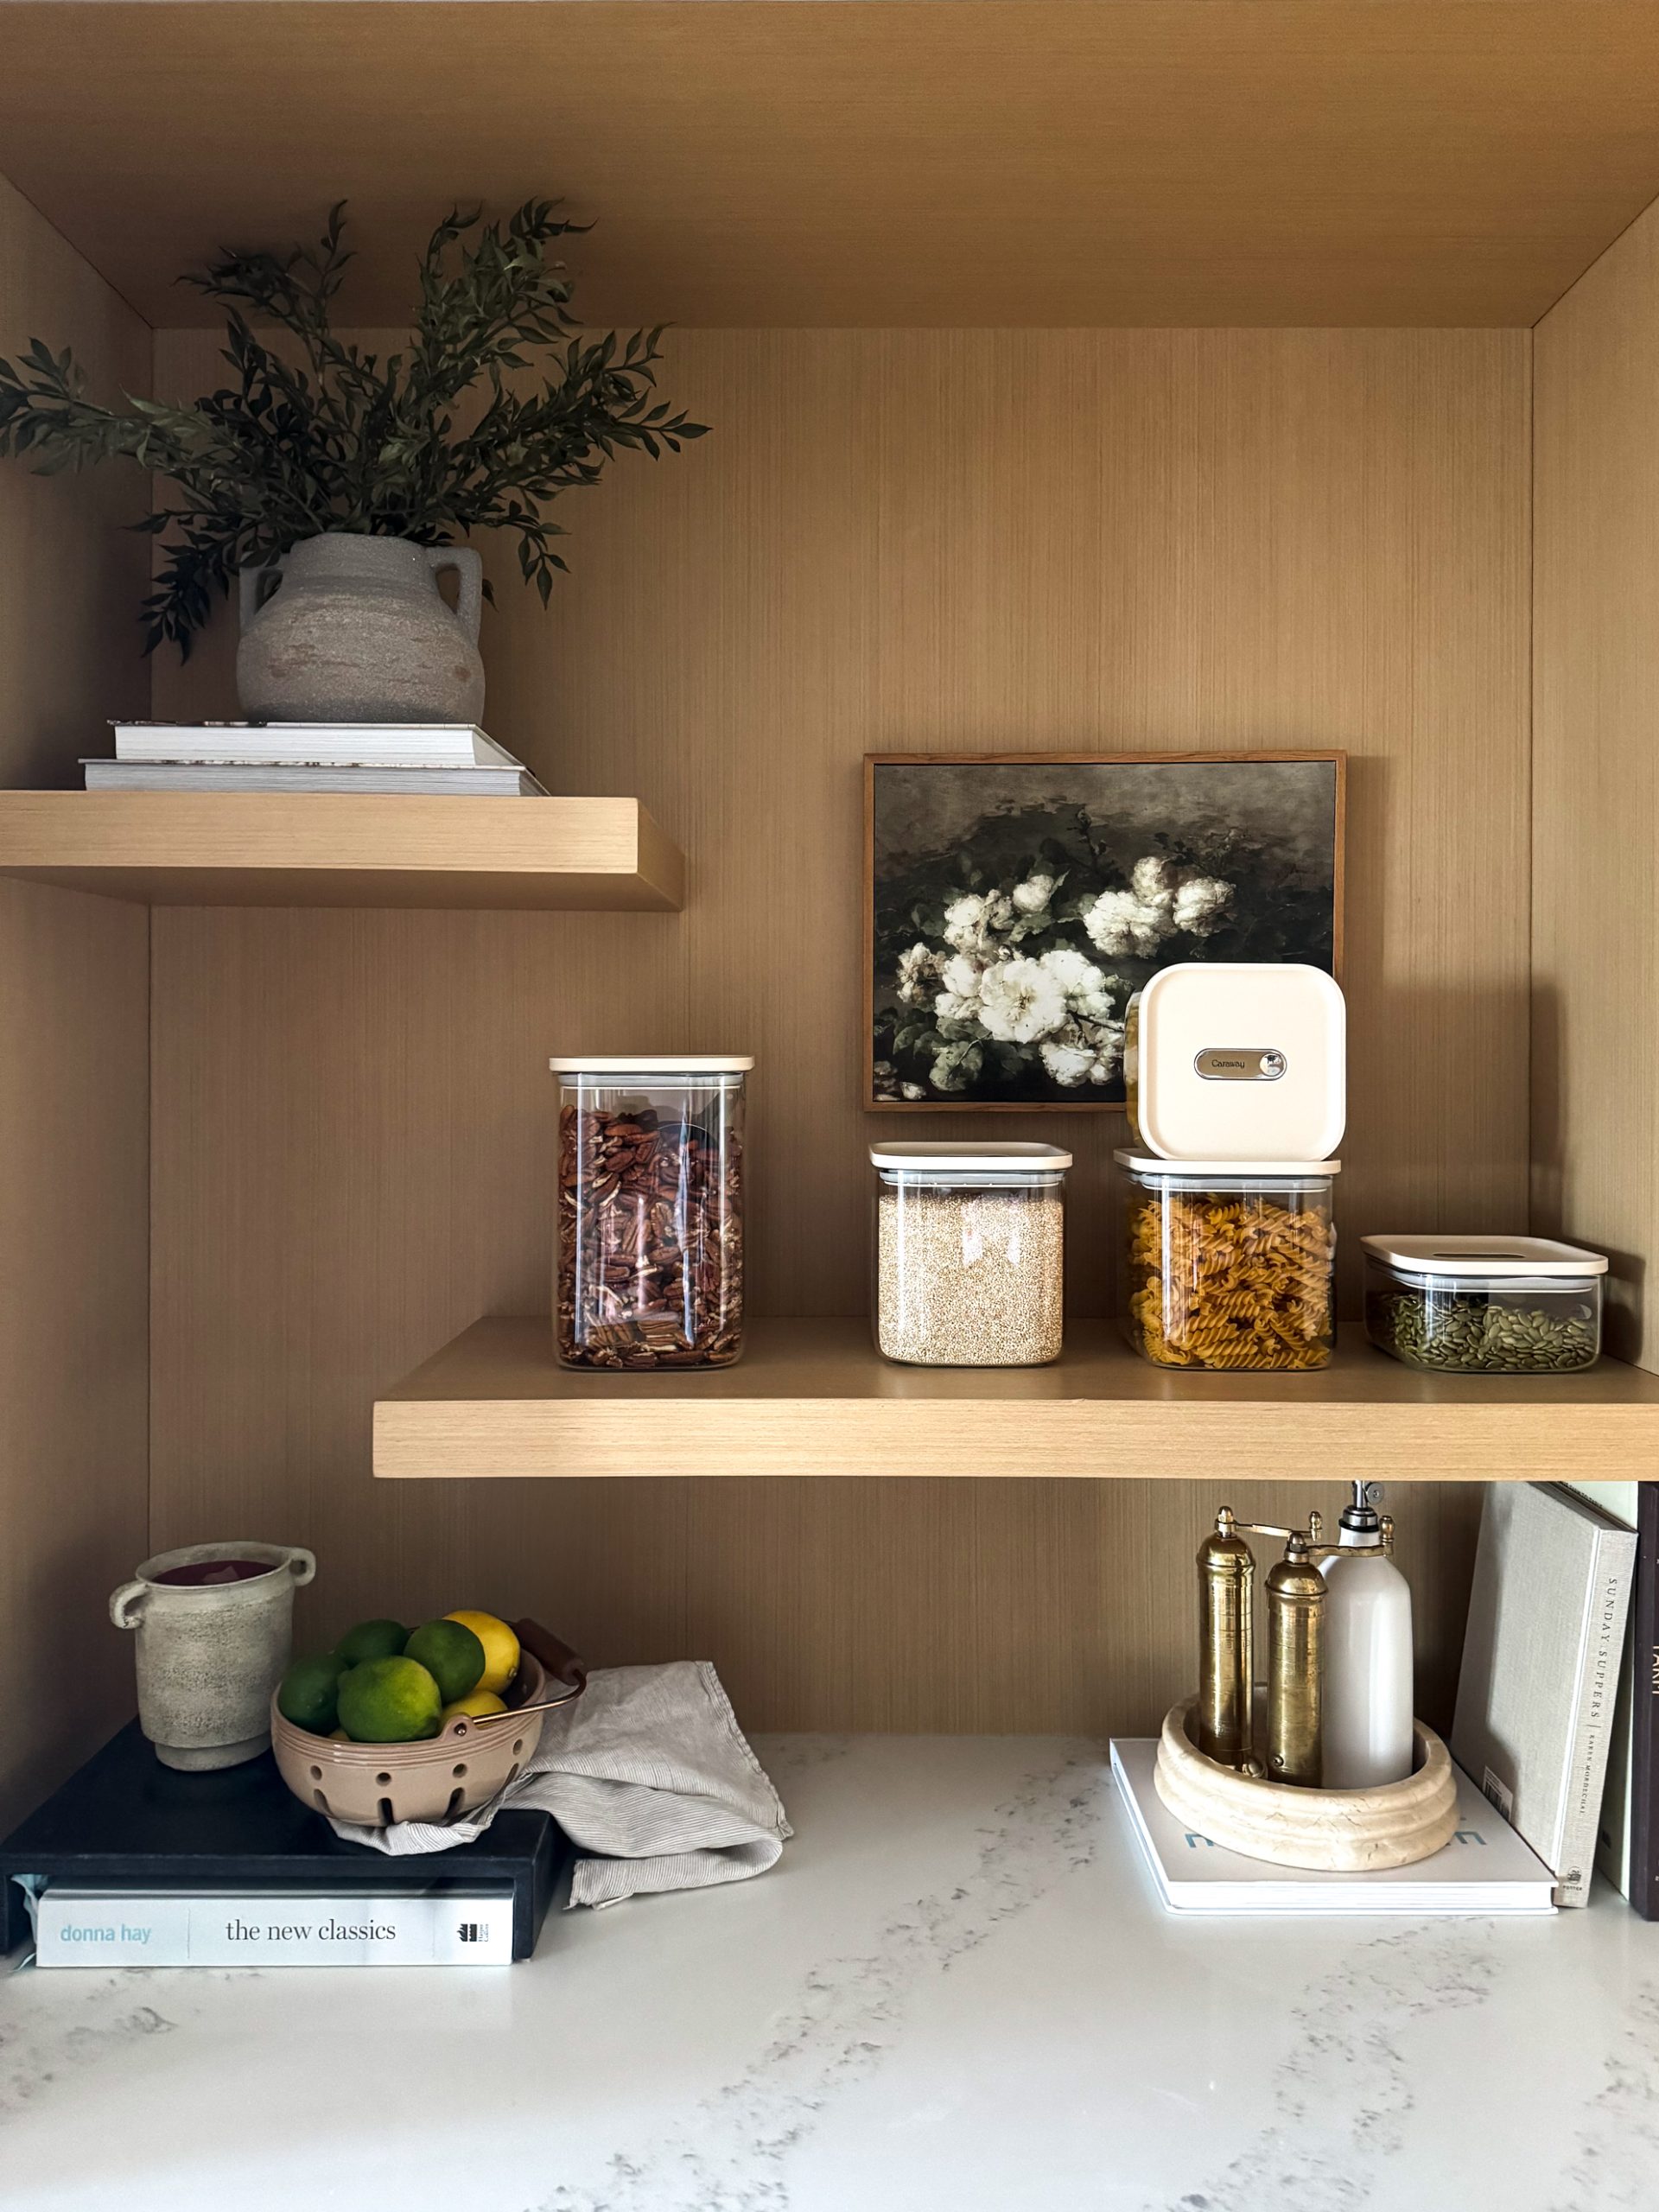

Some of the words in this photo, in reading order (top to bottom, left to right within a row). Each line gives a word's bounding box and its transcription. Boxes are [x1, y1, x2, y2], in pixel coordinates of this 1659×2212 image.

[1211, 1059, 1245, 1069] Caraway
[1601, 1578, 1618, 1642] SUNDAY
[1591, 1650, 1608, 1718] SUPPERS
[1586, 1734, 1595, 1762] KAREN
[1580, 1764, 1591, 1814] MORDECHAI
[60, 1924, 115, 1942] donna
[121, 1923, 151, 1944] hay
[226, 1919, 260, 1940] the
[268, 1925, 312, 1940] new
[319, 1919, 396, 1940] classics
